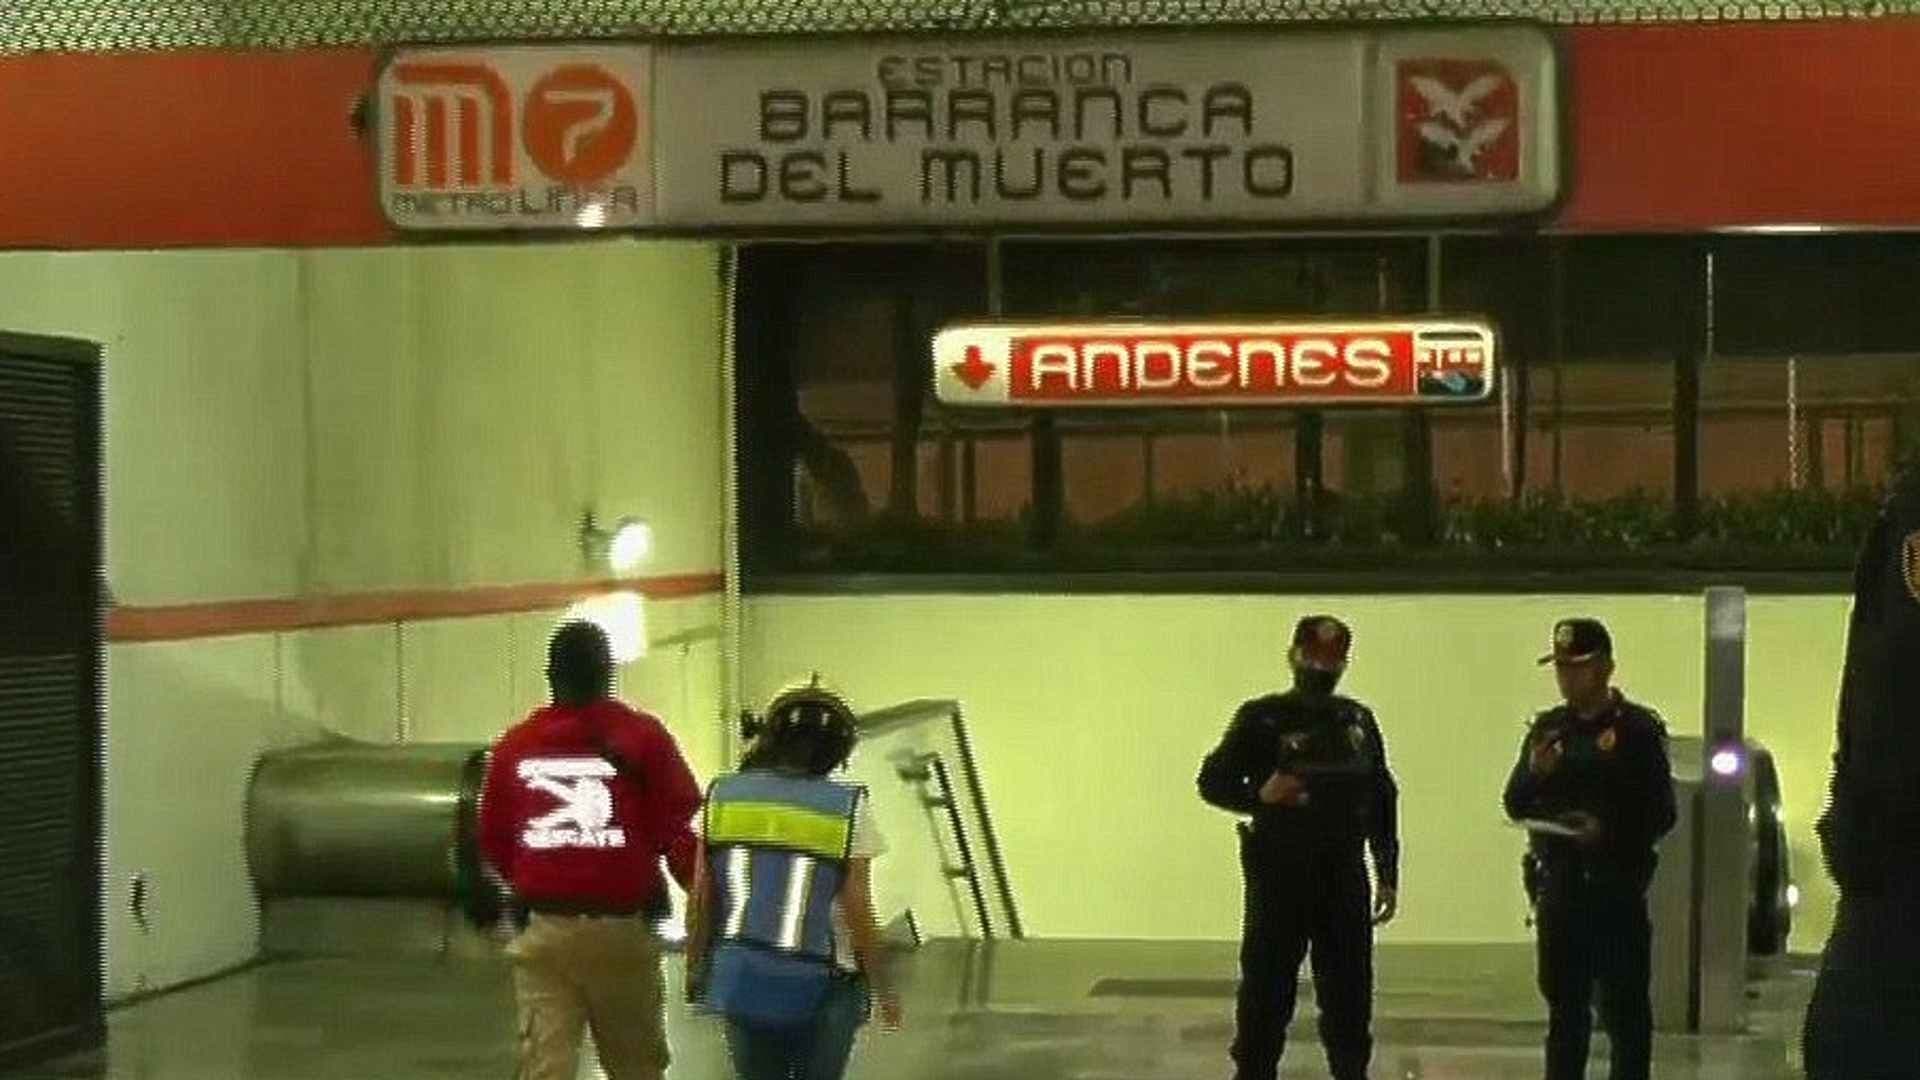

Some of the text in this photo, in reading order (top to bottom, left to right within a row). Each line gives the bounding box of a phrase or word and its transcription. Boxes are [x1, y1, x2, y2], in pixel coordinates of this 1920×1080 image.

[878, 52, 1133, 87] ESTACION
[543, 89, 616, 165] 7
[758, 81, 1254, 142] BARRANCA
[519, 185, 637, 213] LINA
[720, 144, 1294, 203] DEL MUERTO
[1030, 339, 1392, 391] ANDENES
